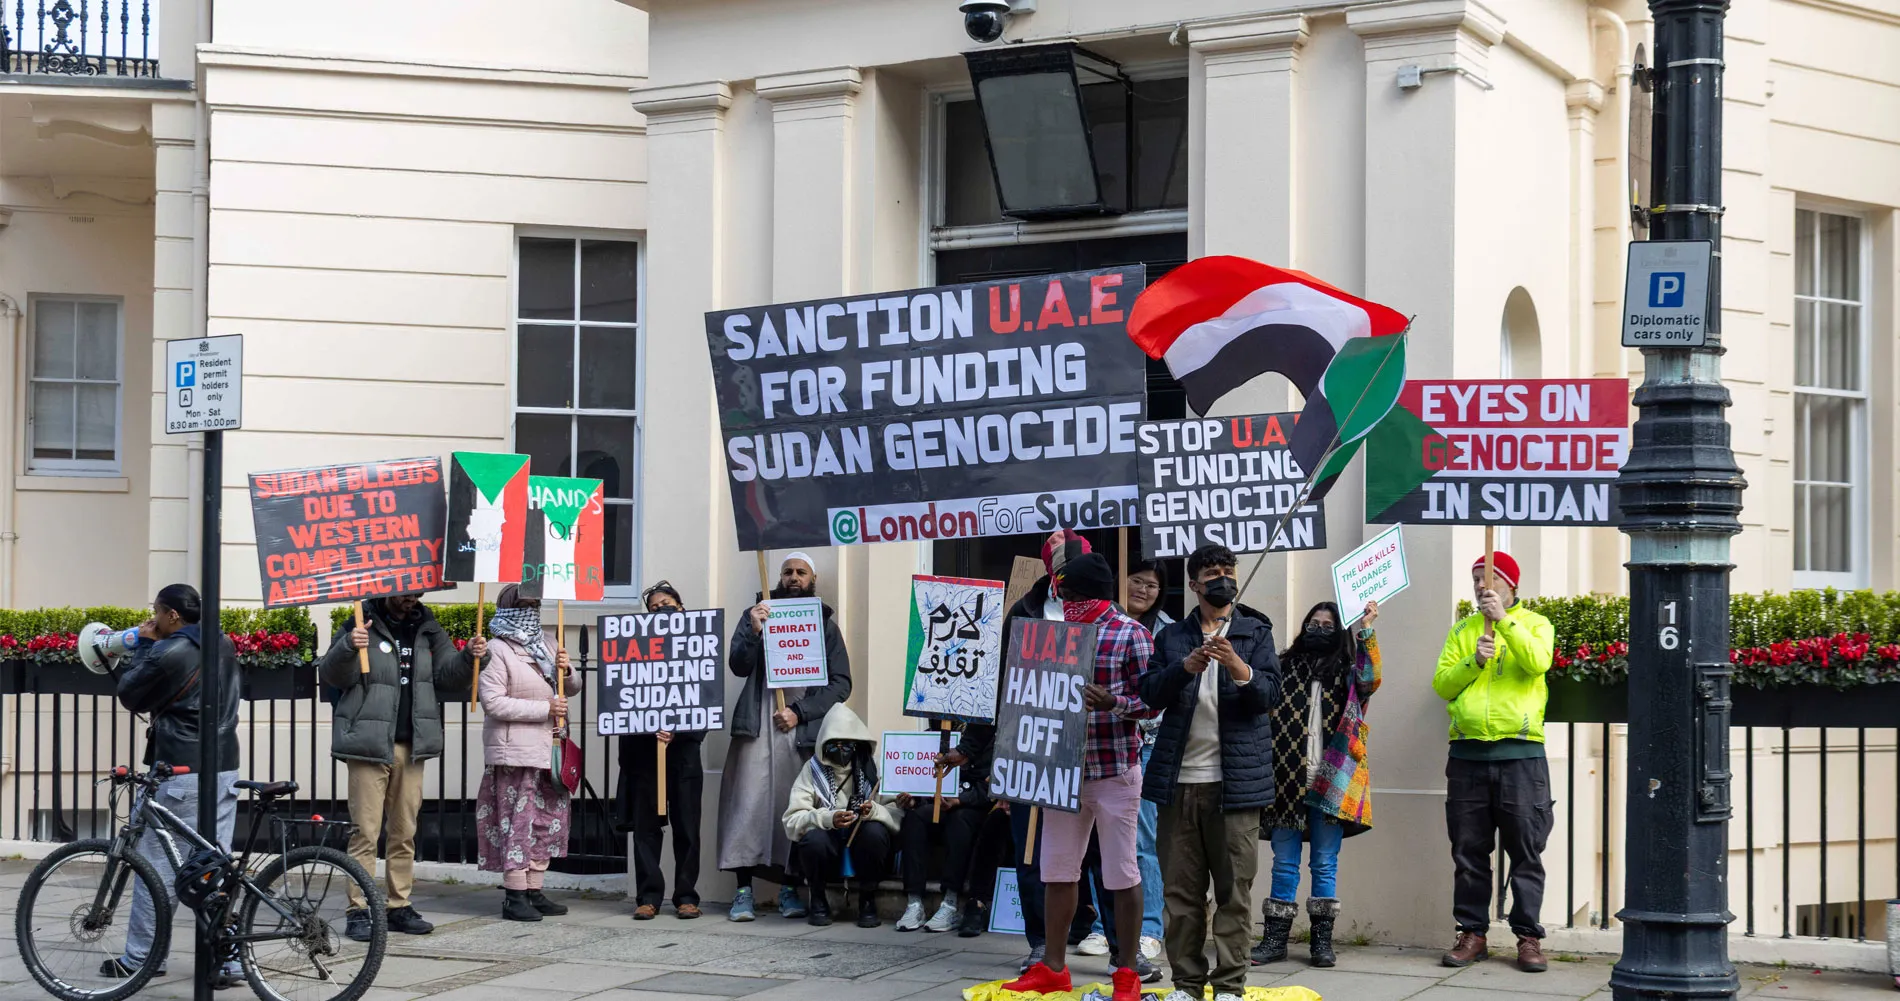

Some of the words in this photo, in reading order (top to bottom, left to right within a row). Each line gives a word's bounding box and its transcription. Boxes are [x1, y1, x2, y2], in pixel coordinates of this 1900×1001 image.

[1657, 276, 1680, 304] P
[723, 289, 974, 361] SANCTION
[988, 273, 1124, 334] U.A.E
[1630, 314, 1700, 327] Diplomatic
[1634, 330, 1661, 340] cars
[1666, 329, 1694, 341] only
[180, 363, 194, 386] P
[200, 358, 232, 368] Resident
[203, 370, 228, 380] permit
[202, 381, 229, 390] holders
[760, 366, 848, 419] FOR
[861, 342, 1087, 410] FUNDING
[183, 394, 188, 402] A
[207, 393, 223, 401] only
[1422, 384, 1529, 422] EYES
[1540, 384, 1590, 422] ON
[186, 410, 201, 418] Mon
[208, 408, 221, 416] Sat
[204, 418, 225, 427] 10.00
[226, 419, 237, 427] pm
[727, 425, 874, 482] SUDAN
[884, 401, 1141, 471] GENOCIDE
[1138, 419, 1223, 455] STOP
[1231, 413, 1301, 448] U.A
[1421, 433, 1620, 471] GENOCIDE
[255, 467, 339, 499] SUDAN
[345, 460, 440, 491] BLEEDS
[1153, 449, 1304, 488] FUNDING
[303, 493, 356, 521] DUE
[361, 490, 397, 515] TO
[527, 485, 602, 514] HANDS
[1145, 482, 1318, 523] GENOCIDE
[1421, 482, 1469, 520] IN
[1481, 483, 1609, 521] SUDAN
[287, 514, 421, 549] WESTERN
[549, 520, 586, 543] OFF
[1153, 525, 1197, 556] IN
[265, 537, 444, 578] COMPLICITY
[1341, 568, 1357, 583] THE
[1357, 557, 1374, 572] UAE
[1374, 543, 1396, 562] KILLS
[522, 562, 601, 589] DARFUR
[1351, 560, 1392, 591] SUDANESE
[1358, 577, 1388, 601] PEOPLE
[267, 577, 319, 606] AND
[604, 610, 717, 639] BOYCOTT
[768, 609, 815, 619] BOYCOTT
[769, 623, 817, 634] EMIRATI
[927, 592, 984, 648] لازم
[602, 637, 665, 663] U.A.E
[672, 634, 719, 659] FOR
[778, 639, 810, 648] GOLD
[787, 653, 804, 661] AND
[1021, 621, 1083, 665] U.A.E
[606, 659, 715, 687] FUNDING
[773, 666, 820, 676] TOURISM
[619, 683, 700, 709] SUDAN
[1006, 667, 1085, 713] HANDS
[598, 706, 723, 735] GENOCIDE
[1016, 715, 1064, 757] OFF
[885, 751, 900, 760] NO
[902, 751, 915, 760] TO
[991, 757, 1081, 809] SUDAN!
